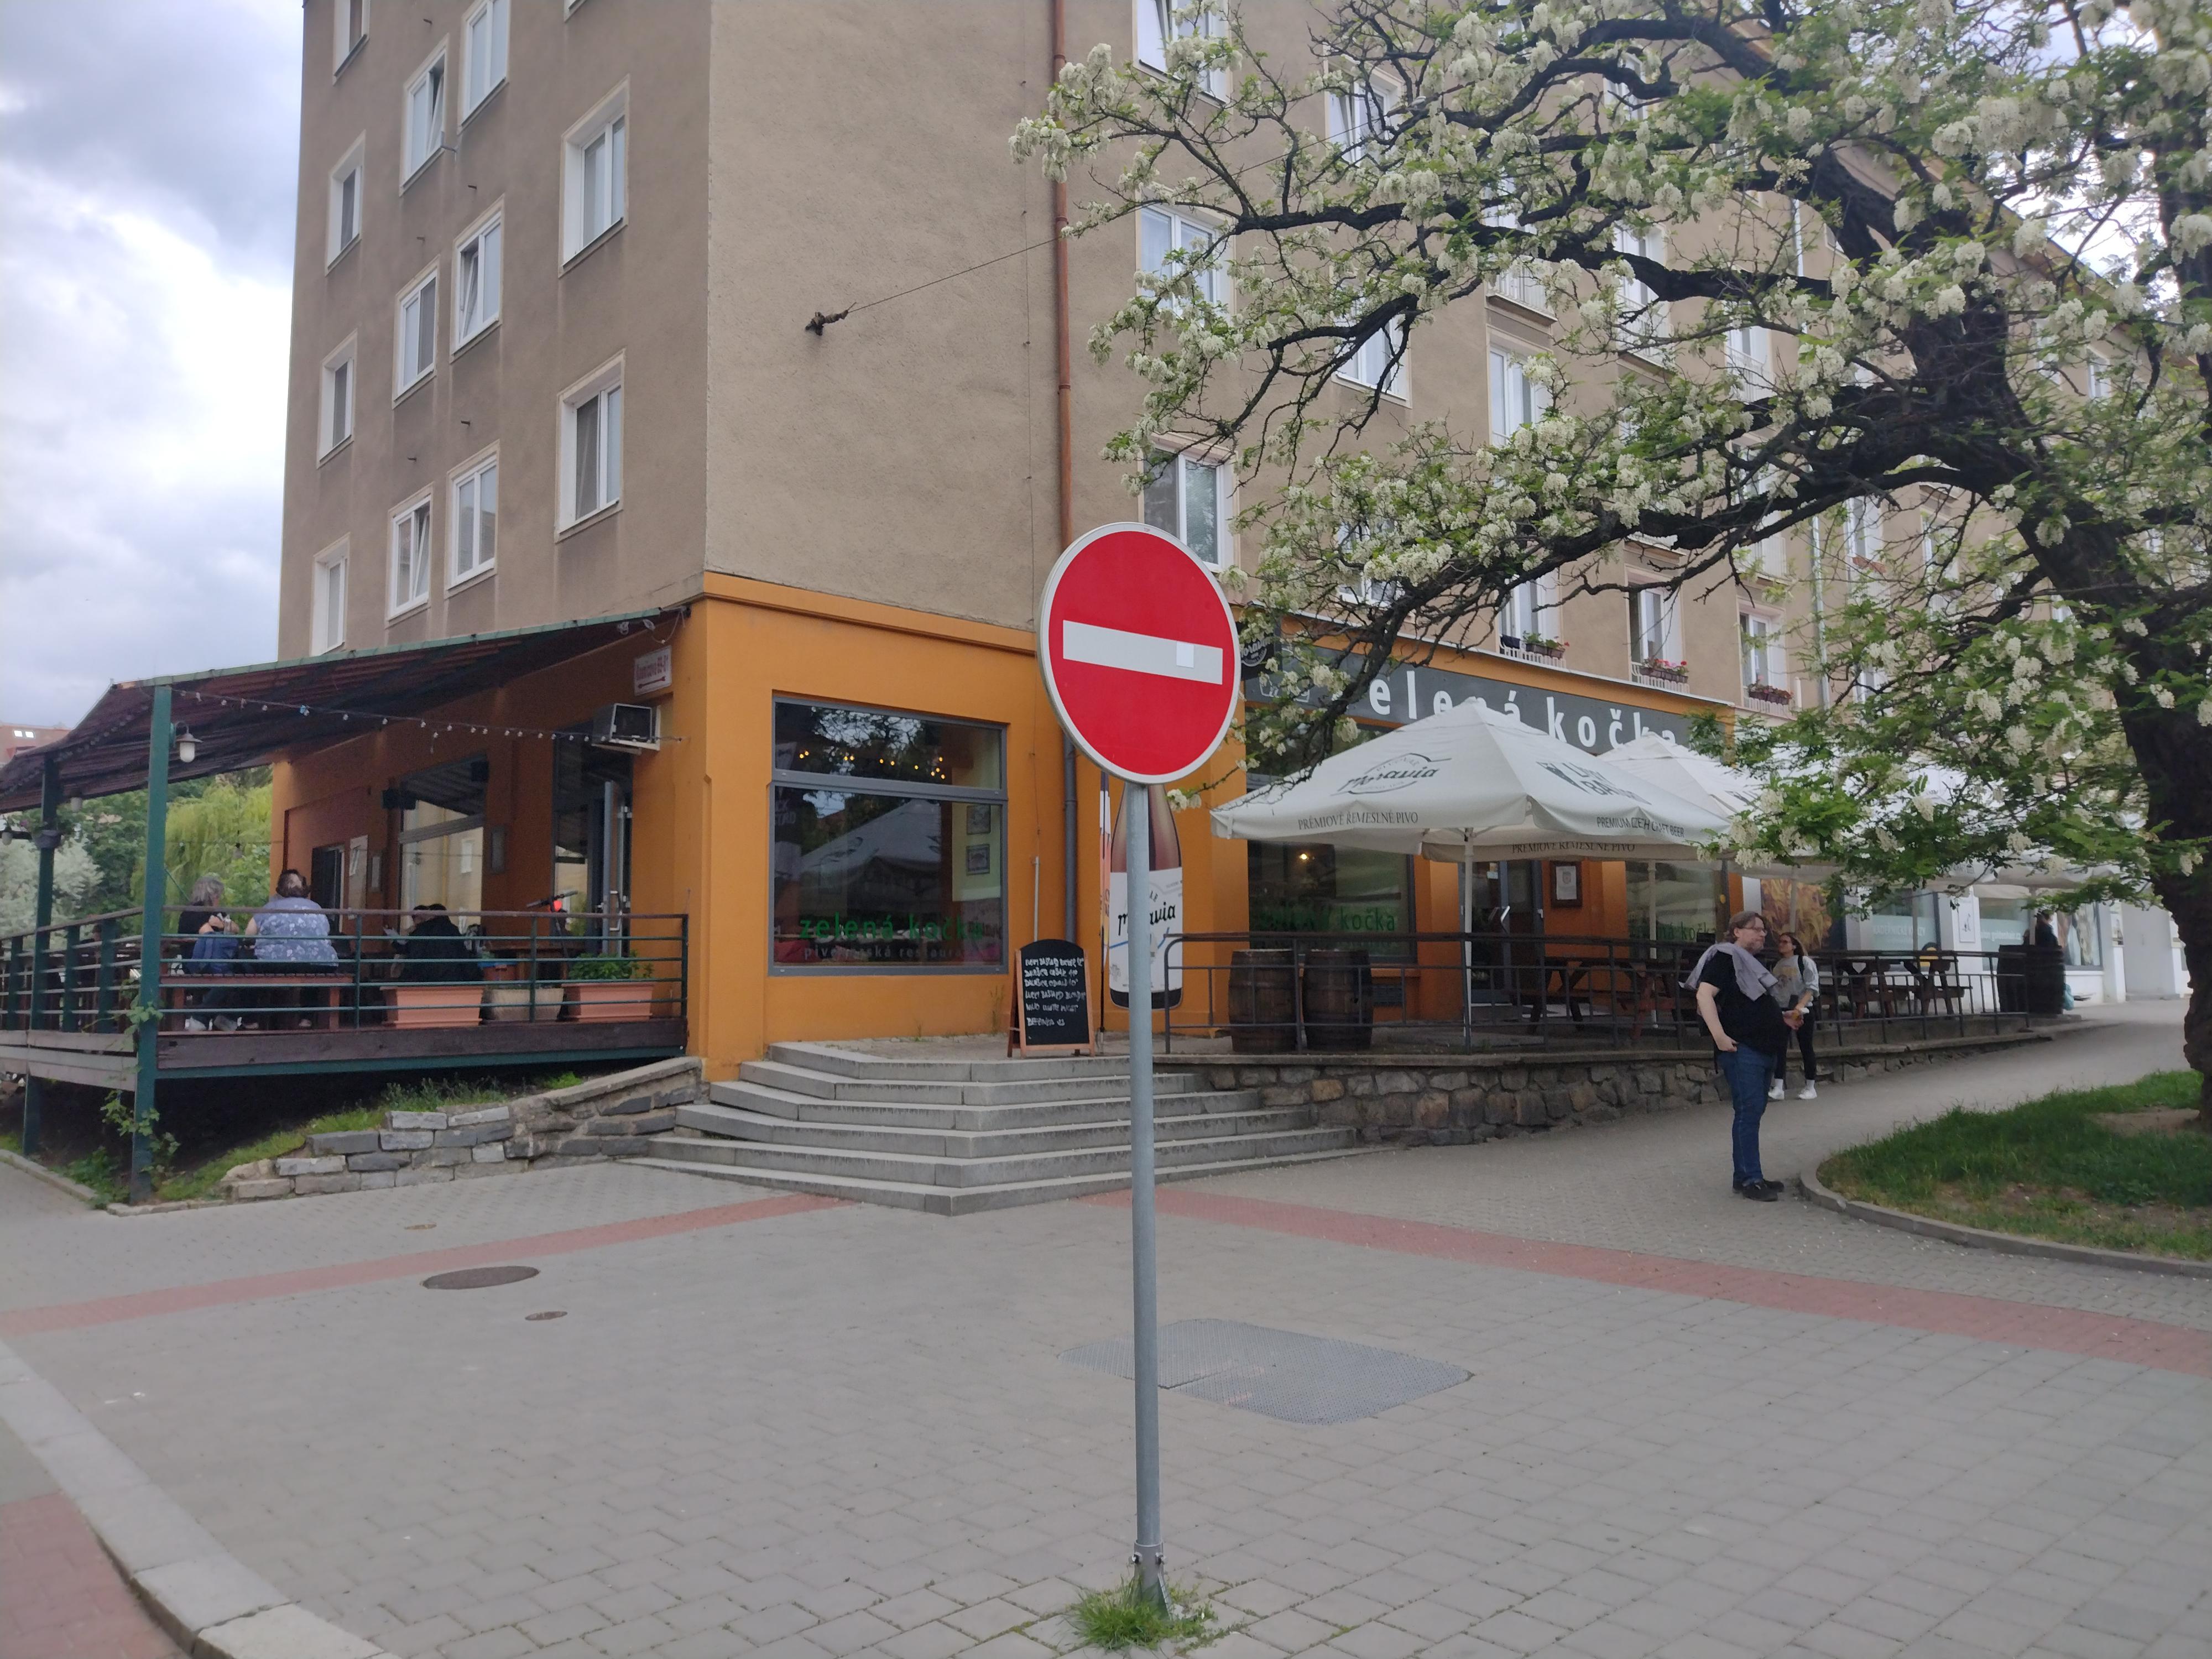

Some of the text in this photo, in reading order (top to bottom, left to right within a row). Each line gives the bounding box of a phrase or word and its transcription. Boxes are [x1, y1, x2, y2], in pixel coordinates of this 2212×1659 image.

[1396, 811, 1418, 823] PIVO
[1597, 816, 1631, 829] PREMIUM
[1670, 825, 1685, 837] BEER
[799, 911, 984, 940] zelená kočka
[1340, 906, 1395, 931] kočka
